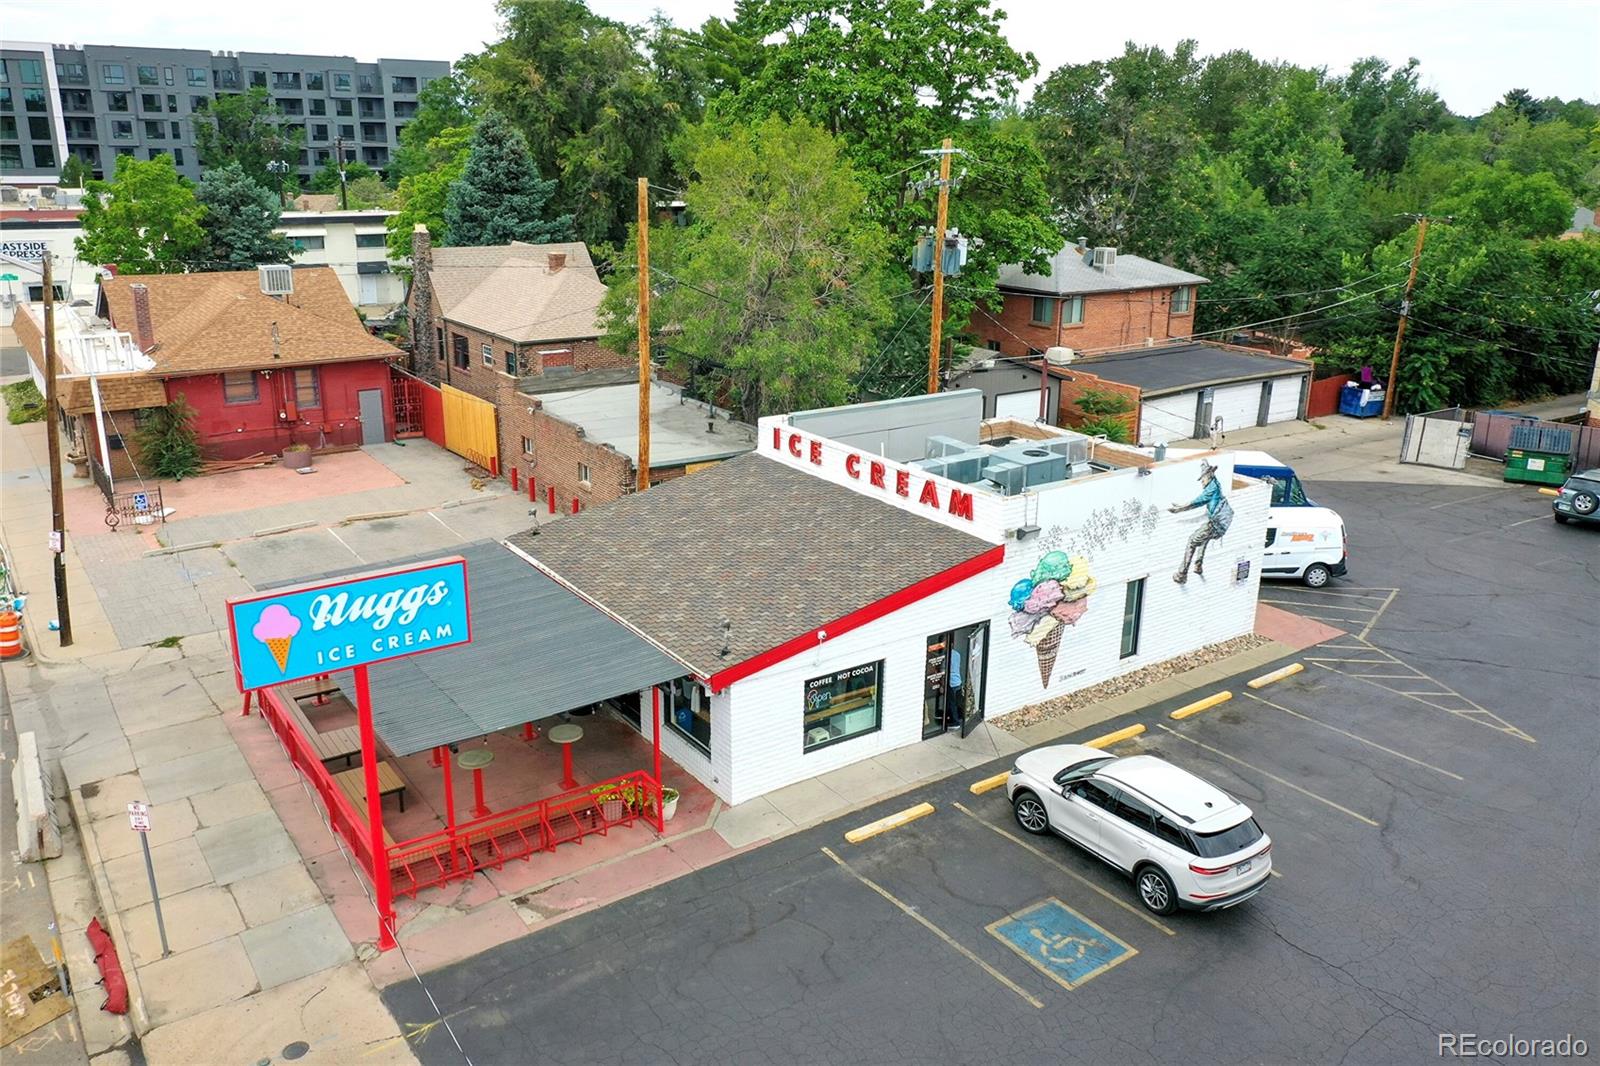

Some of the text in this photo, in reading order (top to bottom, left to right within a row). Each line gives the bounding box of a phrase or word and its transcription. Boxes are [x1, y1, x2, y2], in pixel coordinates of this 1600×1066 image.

[0, 242, 47, 251] ASTSIDE
[773, 427, 974, 521] ICE CREAM
[309, 580, 449, 631] Nuggs
[317, 624, 452, 665] ICE CREAM
[809, 665, 874, 688] COFFEE HOT COCOA
